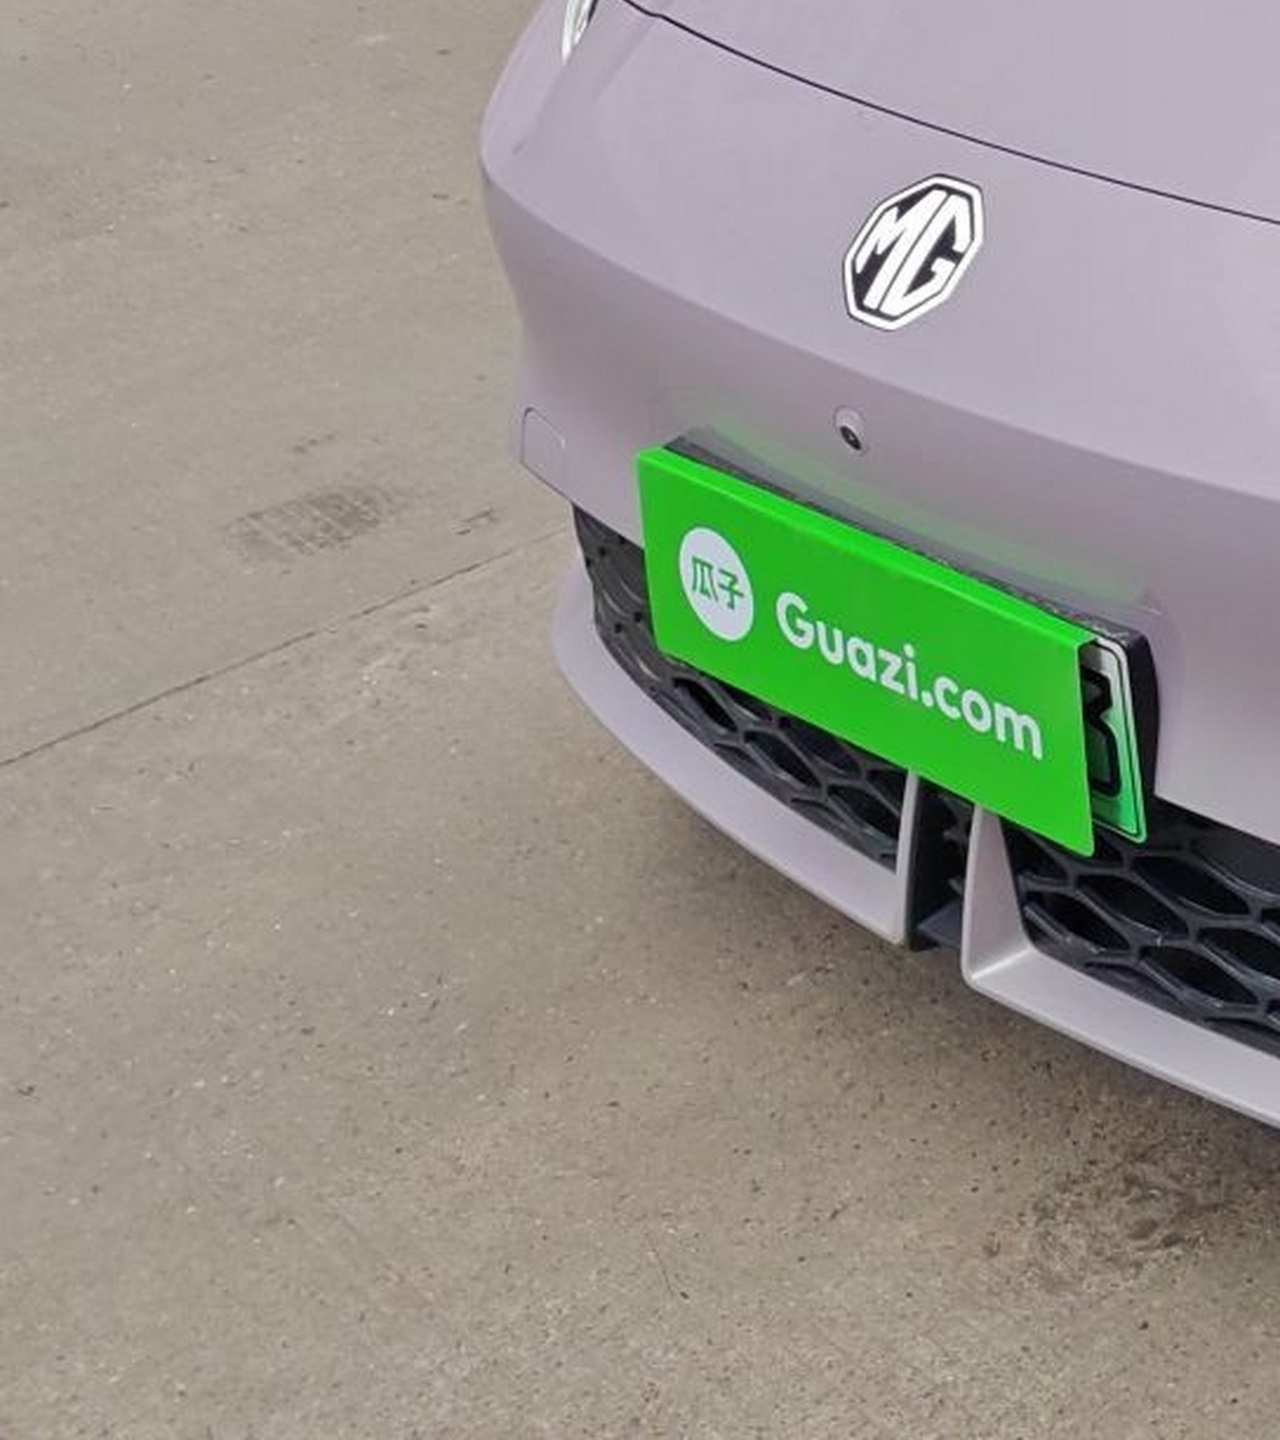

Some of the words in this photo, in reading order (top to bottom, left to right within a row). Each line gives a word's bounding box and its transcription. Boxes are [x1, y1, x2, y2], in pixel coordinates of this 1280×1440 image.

[855, 189, 973, 317] MG
[690, 555, 745, 610] 瓜子
[775, 591, 1044, 760] Guazi.com
